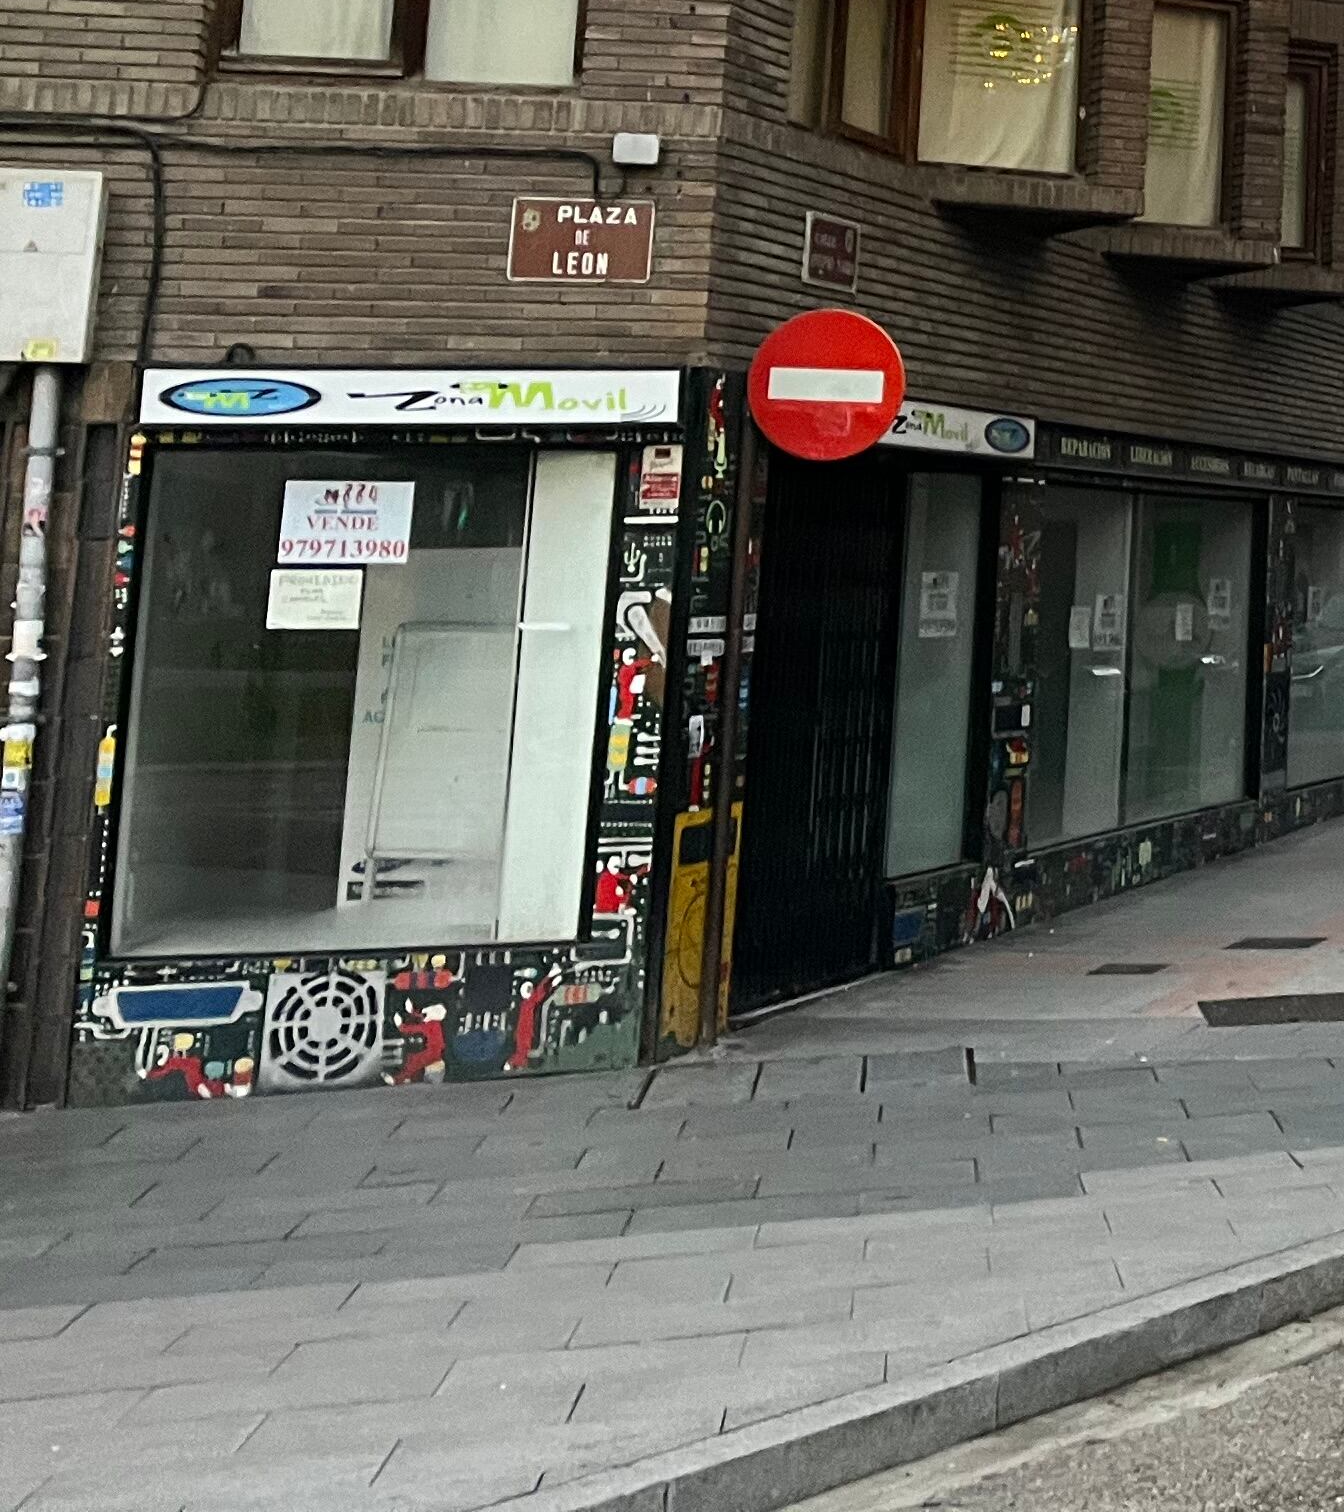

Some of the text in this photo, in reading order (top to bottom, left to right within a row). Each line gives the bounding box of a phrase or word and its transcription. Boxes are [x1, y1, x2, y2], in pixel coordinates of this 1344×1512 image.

[557, 205, 638, 225] PLAZA
[574, 229, 591, 246] DE
[551, 251, 609, 275] LEON
[307, 516, 378, 531] VENDE
[281, 539, 405, 558] 979713980
